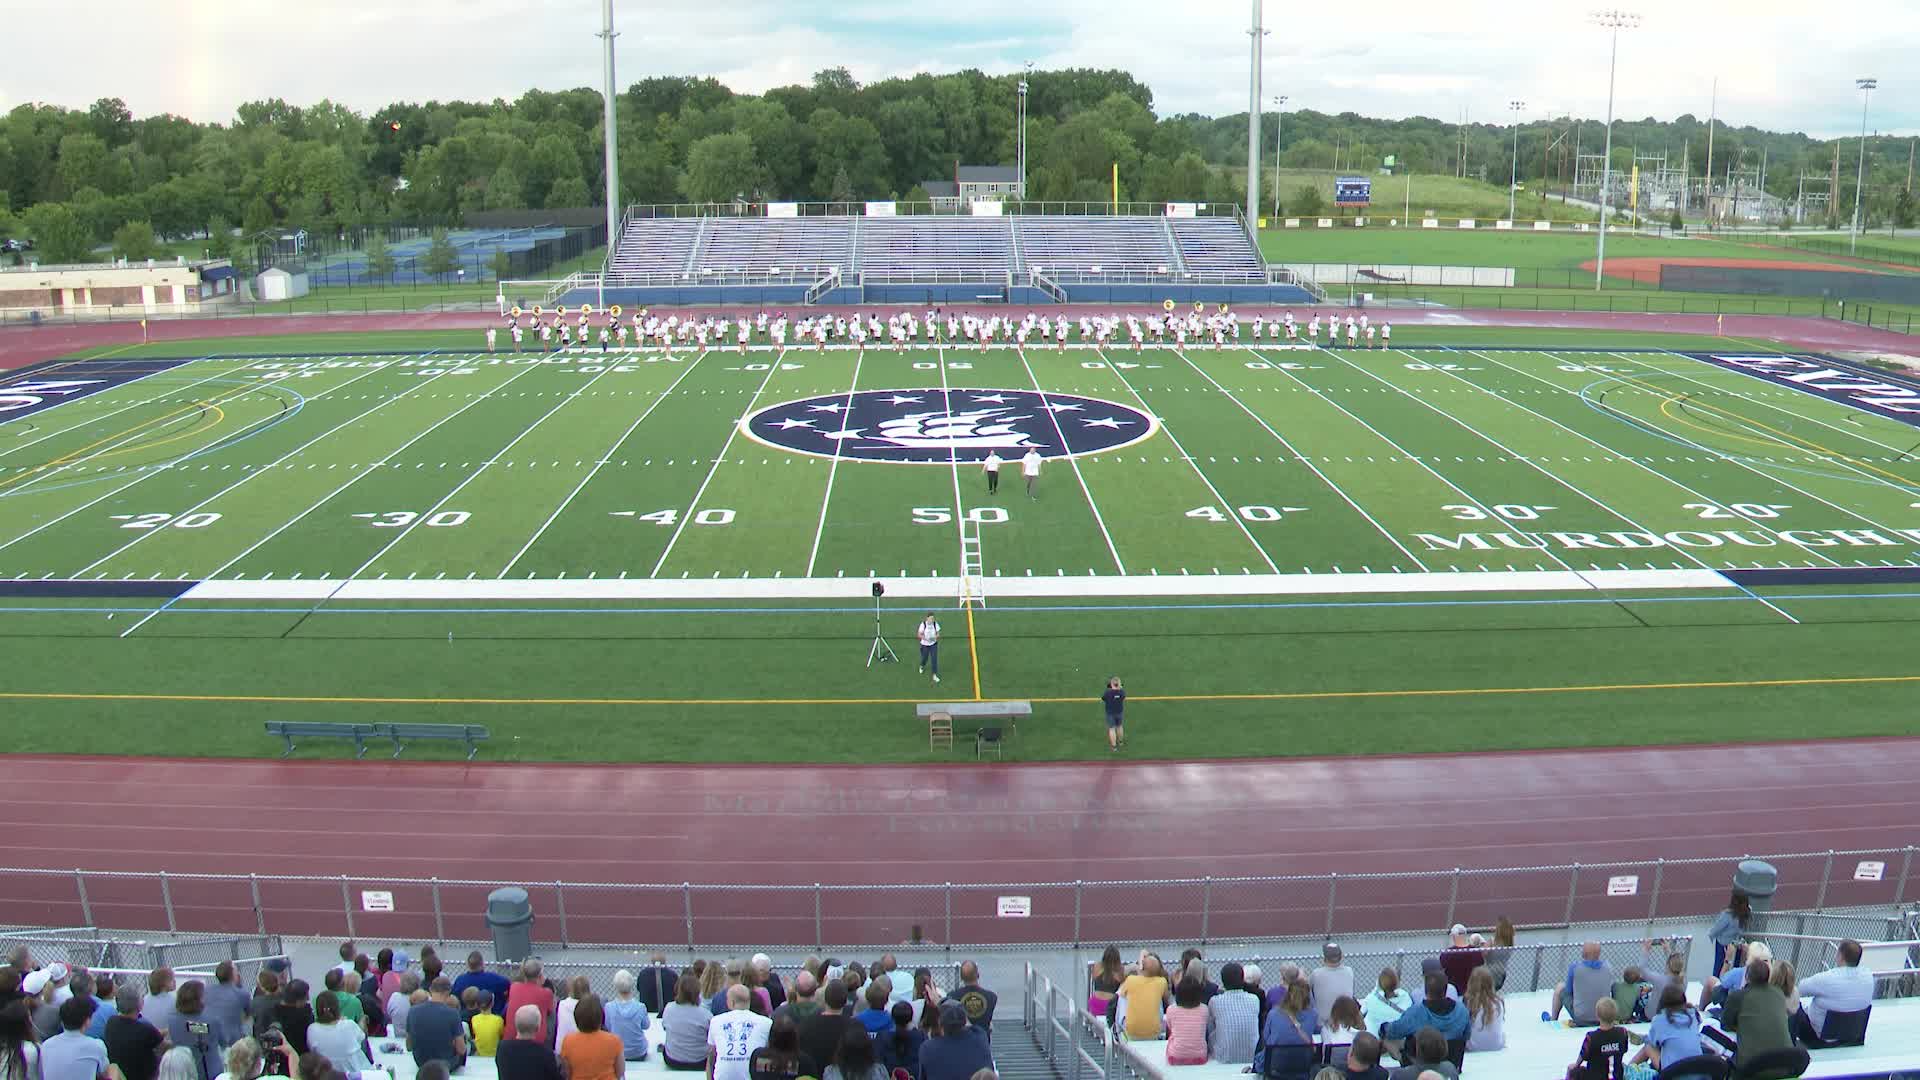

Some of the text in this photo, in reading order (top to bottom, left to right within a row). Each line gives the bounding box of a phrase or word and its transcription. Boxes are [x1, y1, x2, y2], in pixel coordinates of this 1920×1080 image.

[639, 509, 737, 525] 40
[911, 507, 1010, 523] 50
[1184, 505, 1283, 522] 40
[1441, 504, 1542, 520] 30
[1682, 503, 1782, 518] 20
[119, 513, 223, 528] 20
[371, 511, 473, 527] 30
[1408, 529, 1905, 551] MURDOUGH
[1601, 1043, 1620, 1052] CHASE
